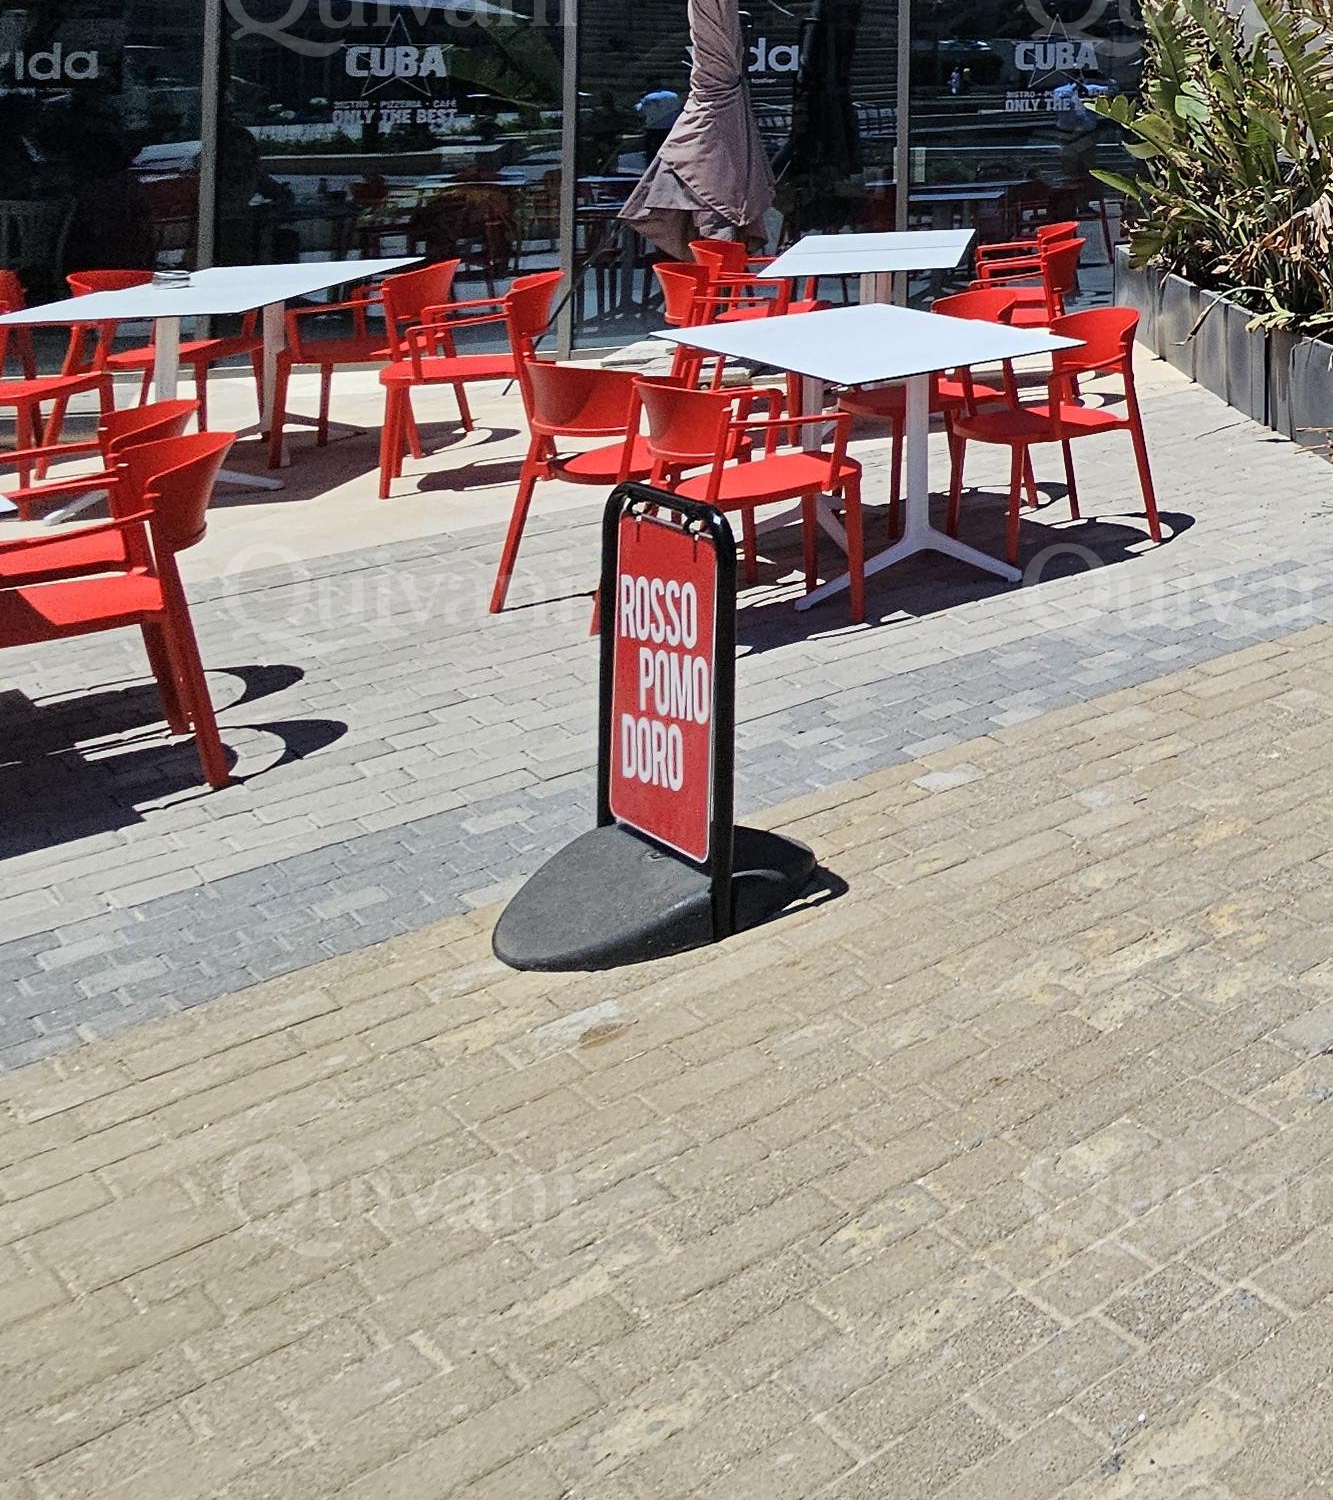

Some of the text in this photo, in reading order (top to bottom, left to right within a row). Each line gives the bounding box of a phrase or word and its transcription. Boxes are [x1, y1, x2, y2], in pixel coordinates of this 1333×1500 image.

[345, 46, 446, 77] CUBA
[1014, 42, 1099, 70] CUBA
[332, 109, 457, 124] ONLY THE BEST
[1005, 100, 1039, 112] ONLY
[1045, 100, 1071, 111] THE
[620, 574, 697, 649] ROSSO
[639, 647, 709, 725] POMO
[621, 713, 684, 792] DORO
